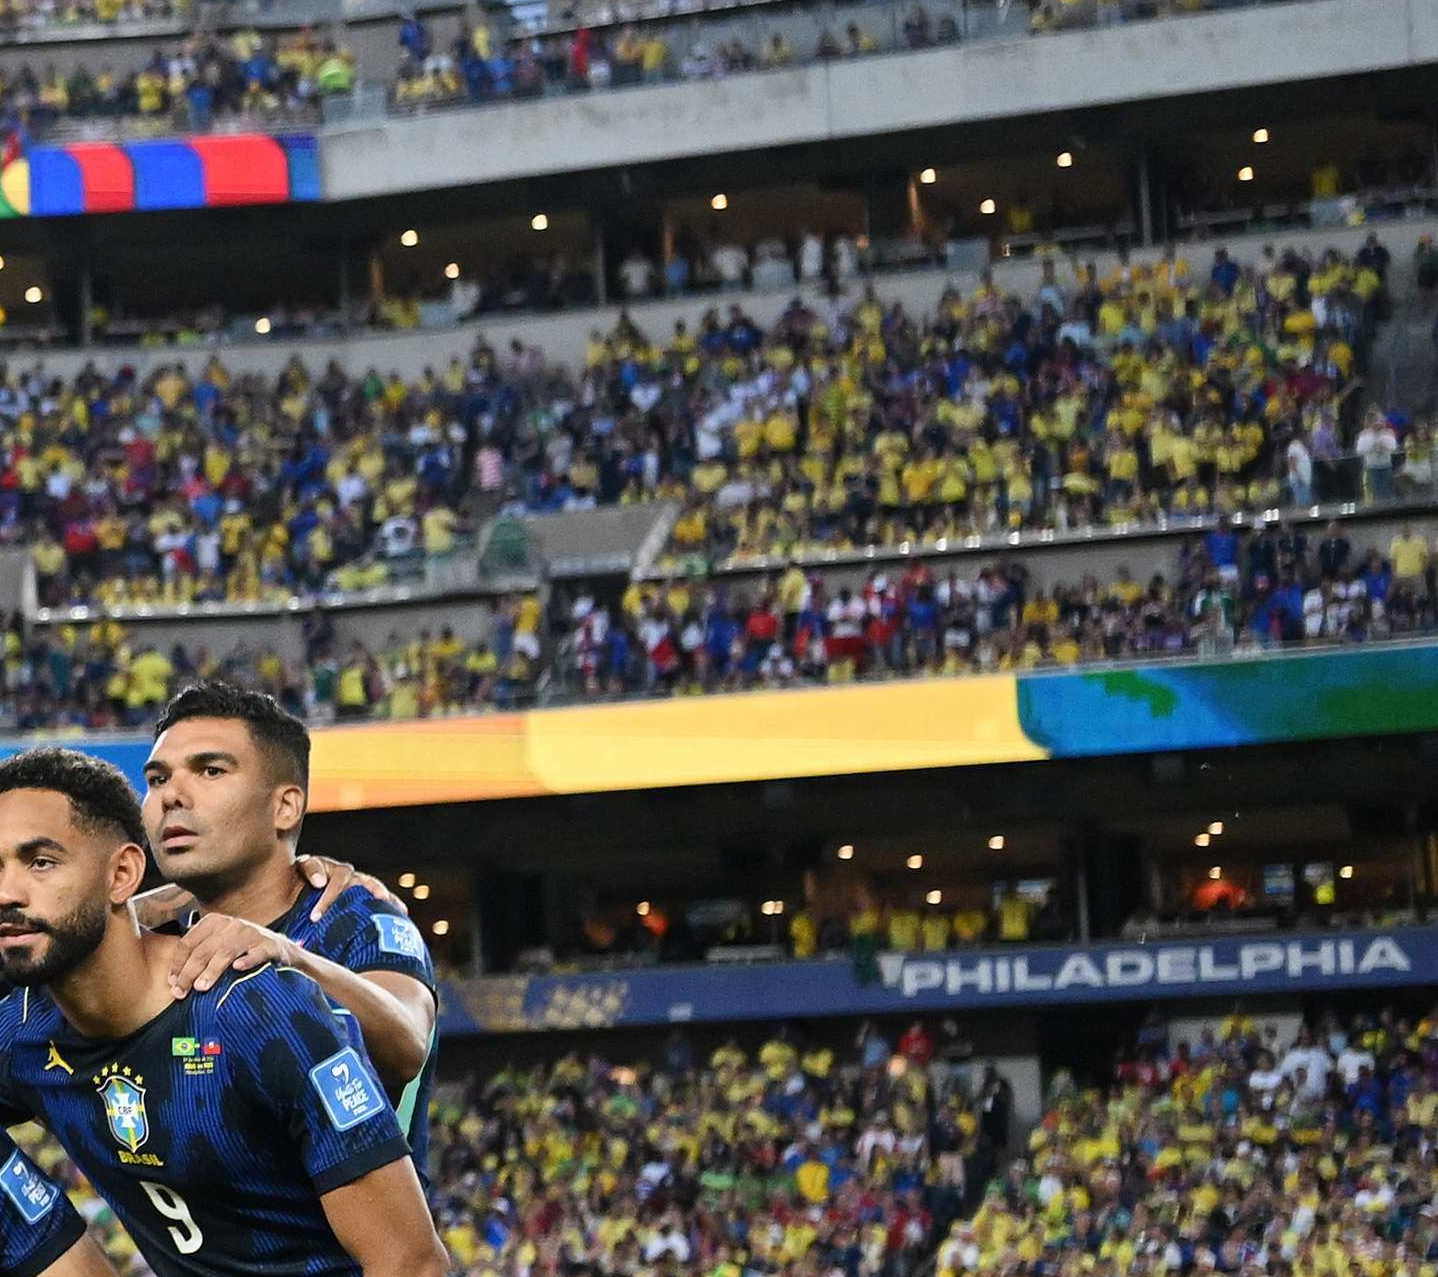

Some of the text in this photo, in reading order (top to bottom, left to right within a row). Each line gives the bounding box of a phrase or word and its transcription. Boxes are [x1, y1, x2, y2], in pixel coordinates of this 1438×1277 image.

[901, 936, 1411, 998] PHILADELPHIA
[117, 1149, 165, 1167] BRASIL
[139, 1180, 204, 1255] 9
